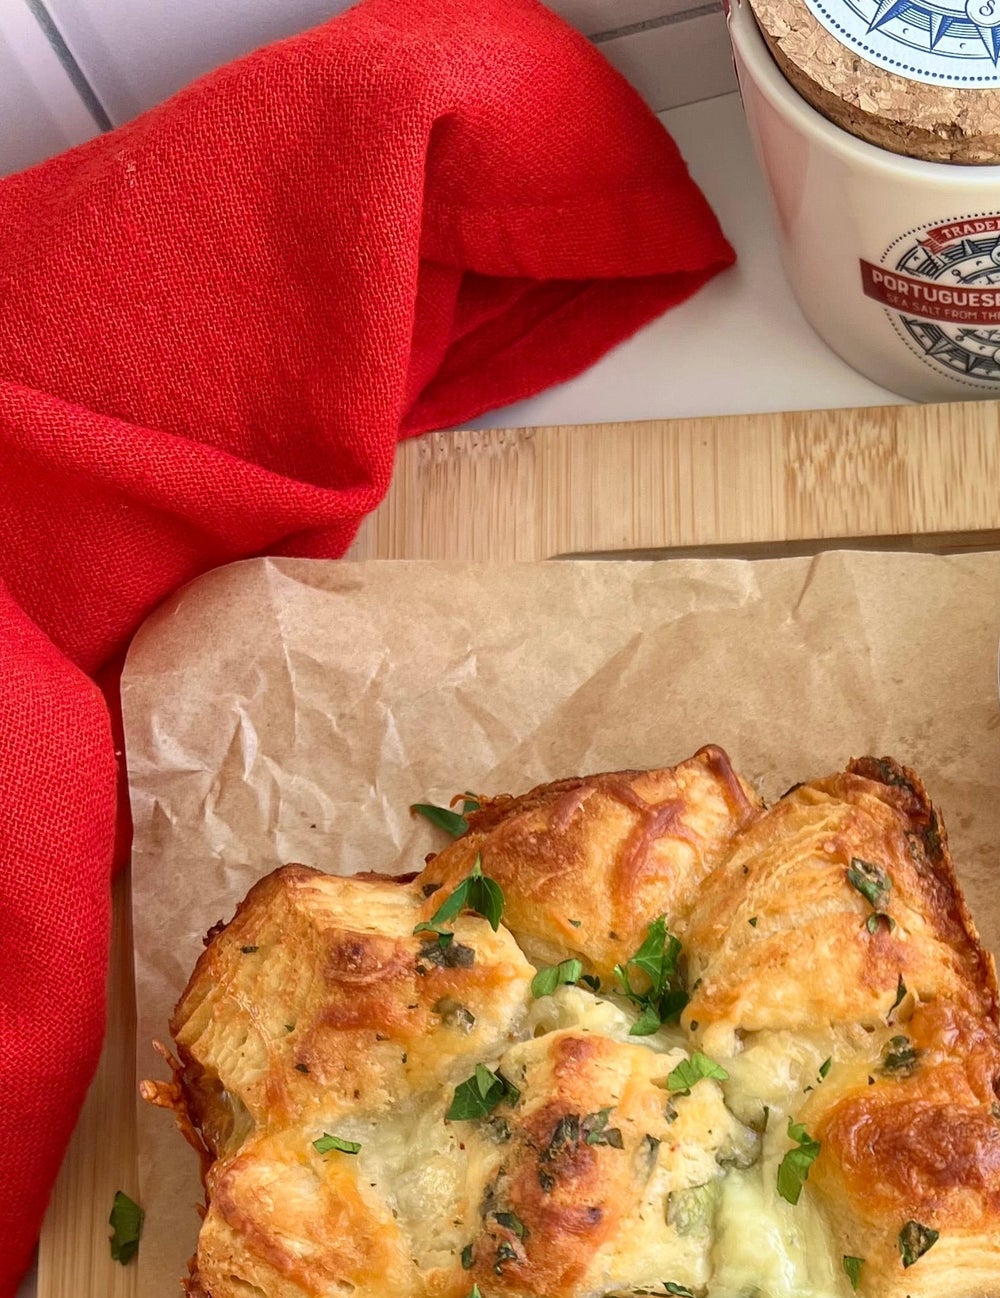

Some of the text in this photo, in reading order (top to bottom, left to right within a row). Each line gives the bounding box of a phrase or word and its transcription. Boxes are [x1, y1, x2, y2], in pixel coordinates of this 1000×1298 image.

[979, 0, 996, 16] S
[887, 293, 908, 309] SEA
[913, 303, 940, 316] SALT
[944, 309, 978, 320] FROM
